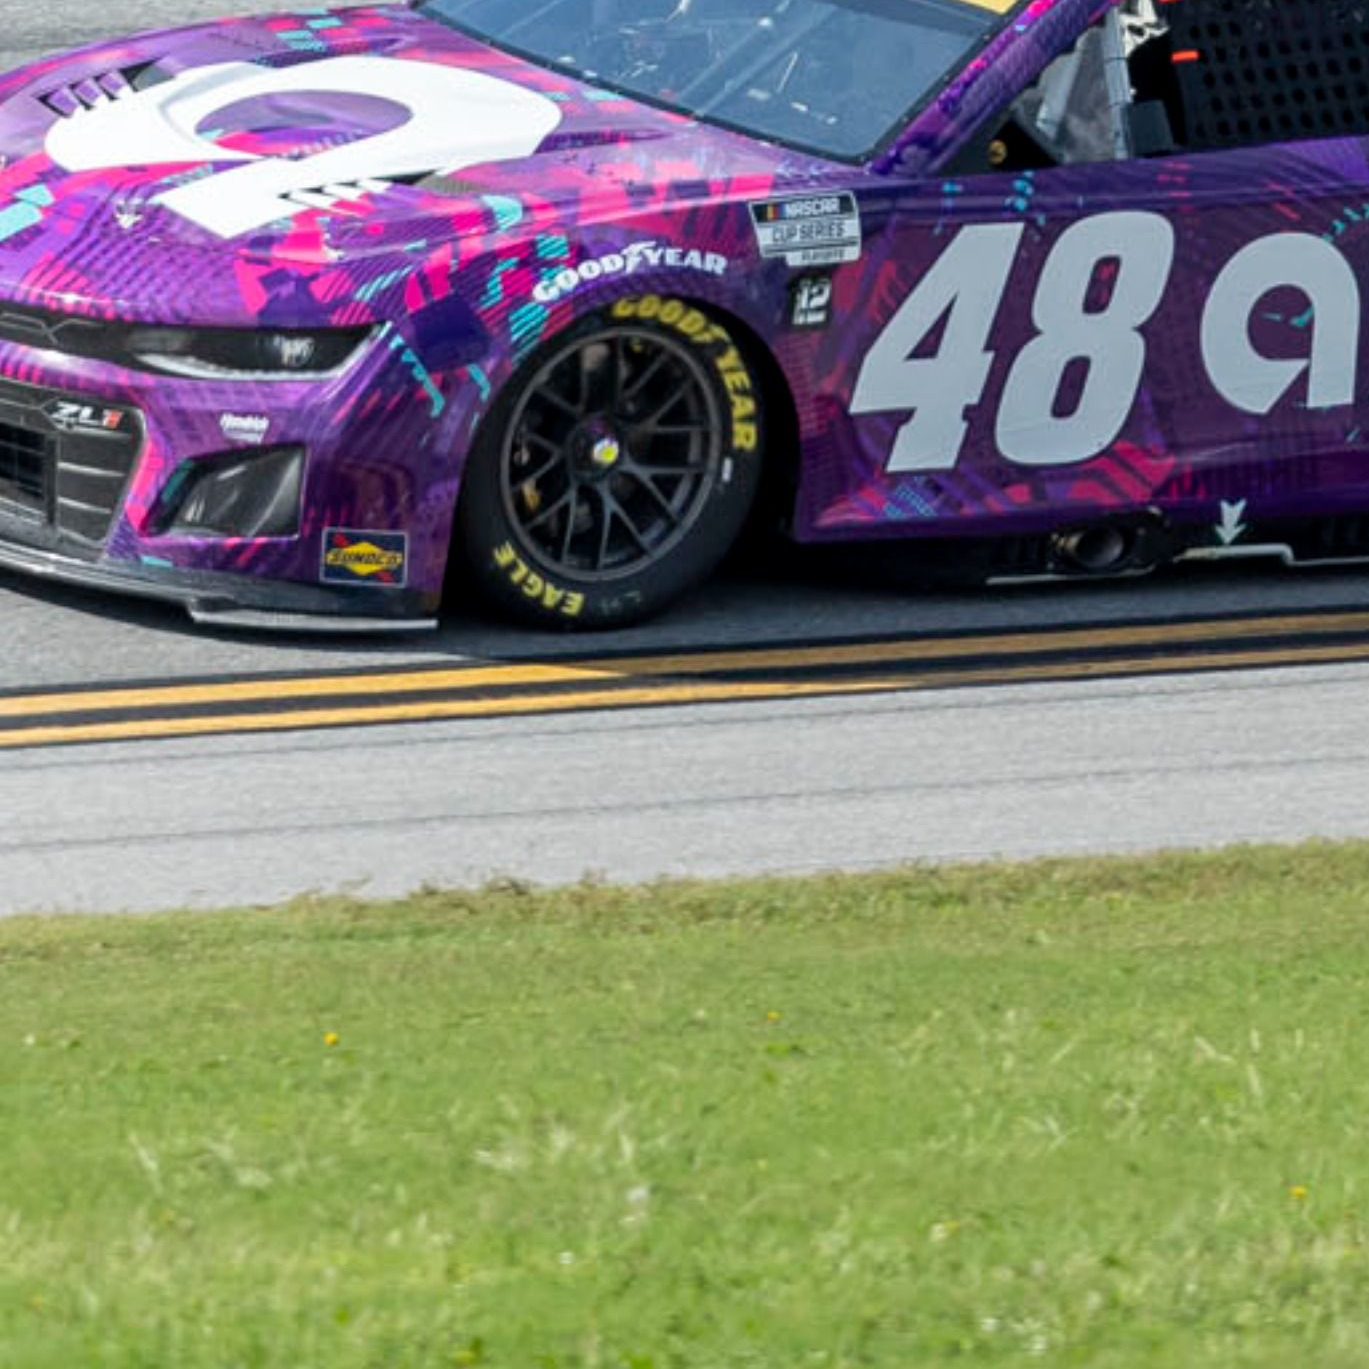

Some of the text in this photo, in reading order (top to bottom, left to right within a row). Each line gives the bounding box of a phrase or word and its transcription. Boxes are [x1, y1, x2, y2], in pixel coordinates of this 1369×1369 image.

[784, 196, 840, 218] NASCAR
[532, 240, 728, 304] GOODYEAR
[612, 293, 759, 452] GOODYEAR
[848, 211, 1174, 473] 48
[324, 546, 404, 569] SUNOCO
[492, 540, 584, 618] EAGLE
